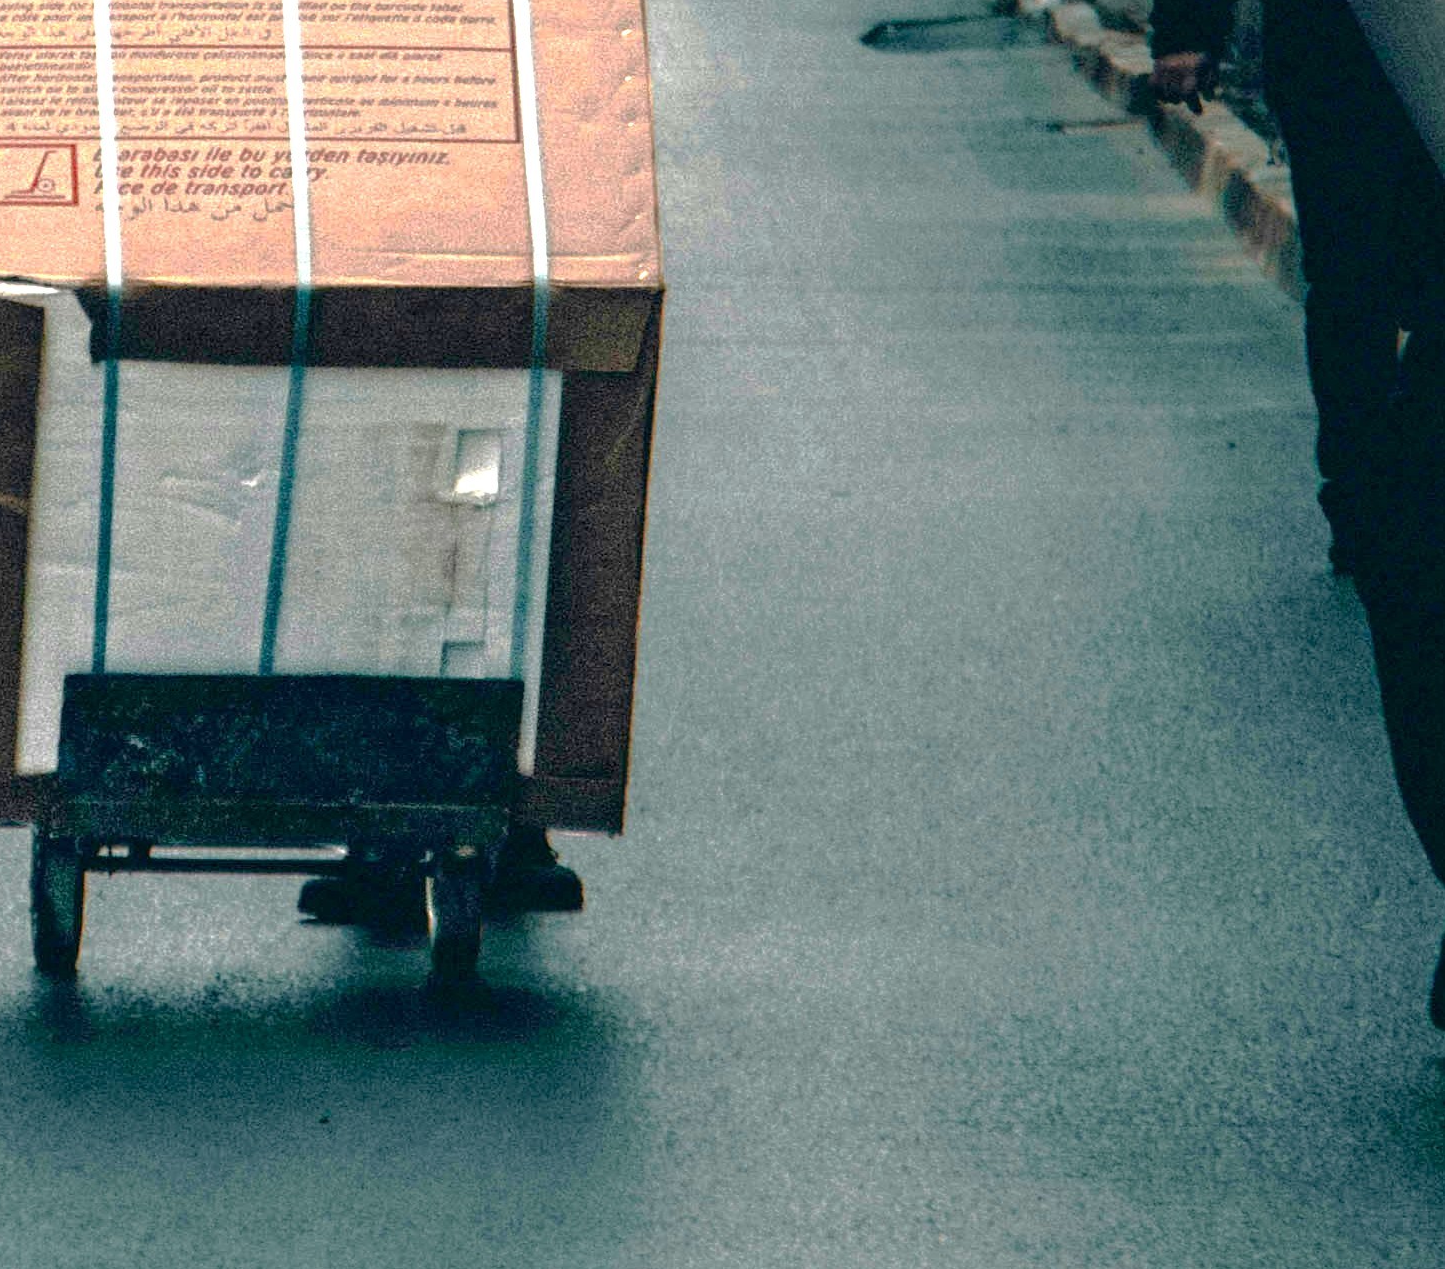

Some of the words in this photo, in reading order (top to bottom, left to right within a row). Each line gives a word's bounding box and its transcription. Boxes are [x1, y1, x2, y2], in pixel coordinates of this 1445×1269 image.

[238, 147, 266, 163] bu
[140, 164, 181, 179] this
[187, 164, 235, 179] side
[241, 164, 263, 179] to
[150, 181, 179, 196] de
